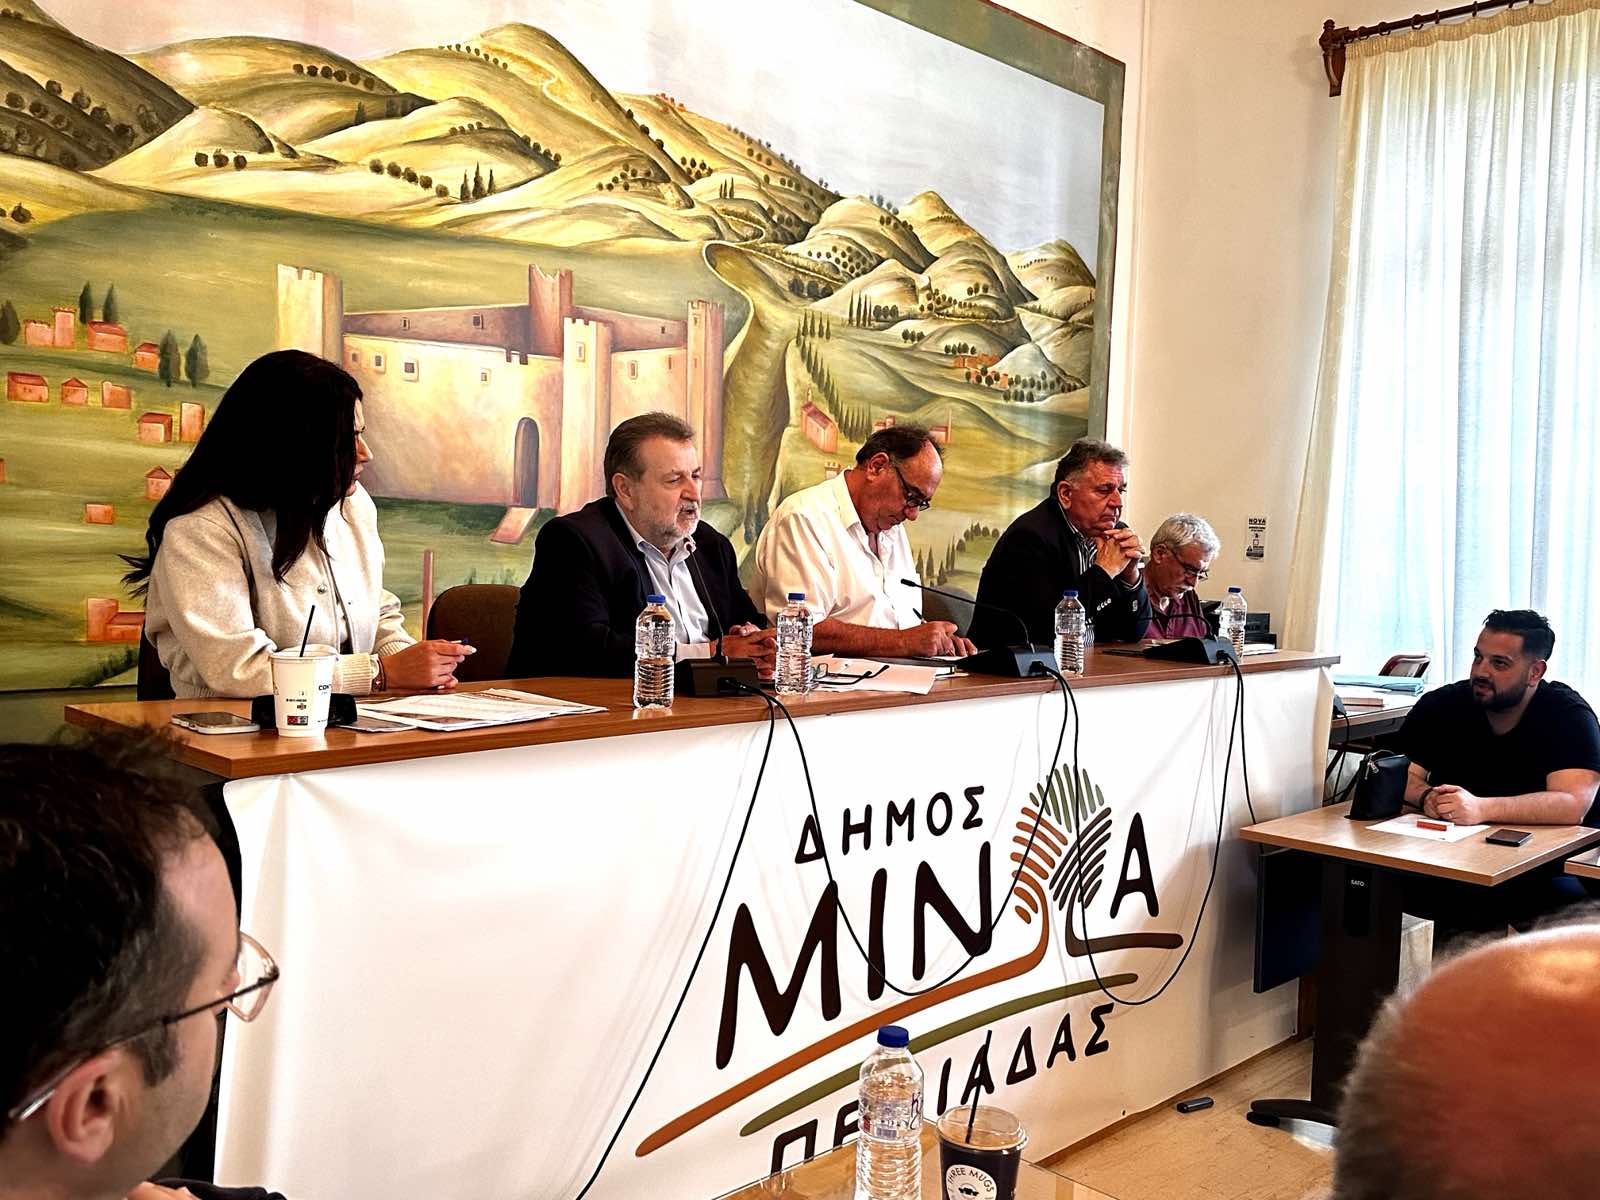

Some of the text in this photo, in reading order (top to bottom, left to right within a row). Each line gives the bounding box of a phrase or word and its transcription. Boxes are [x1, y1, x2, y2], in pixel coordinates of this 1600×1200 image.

[795, 785, 985, 864] ΔΗΜΟΣ
[947, 1168, 995, 1192] THREE MUGS
